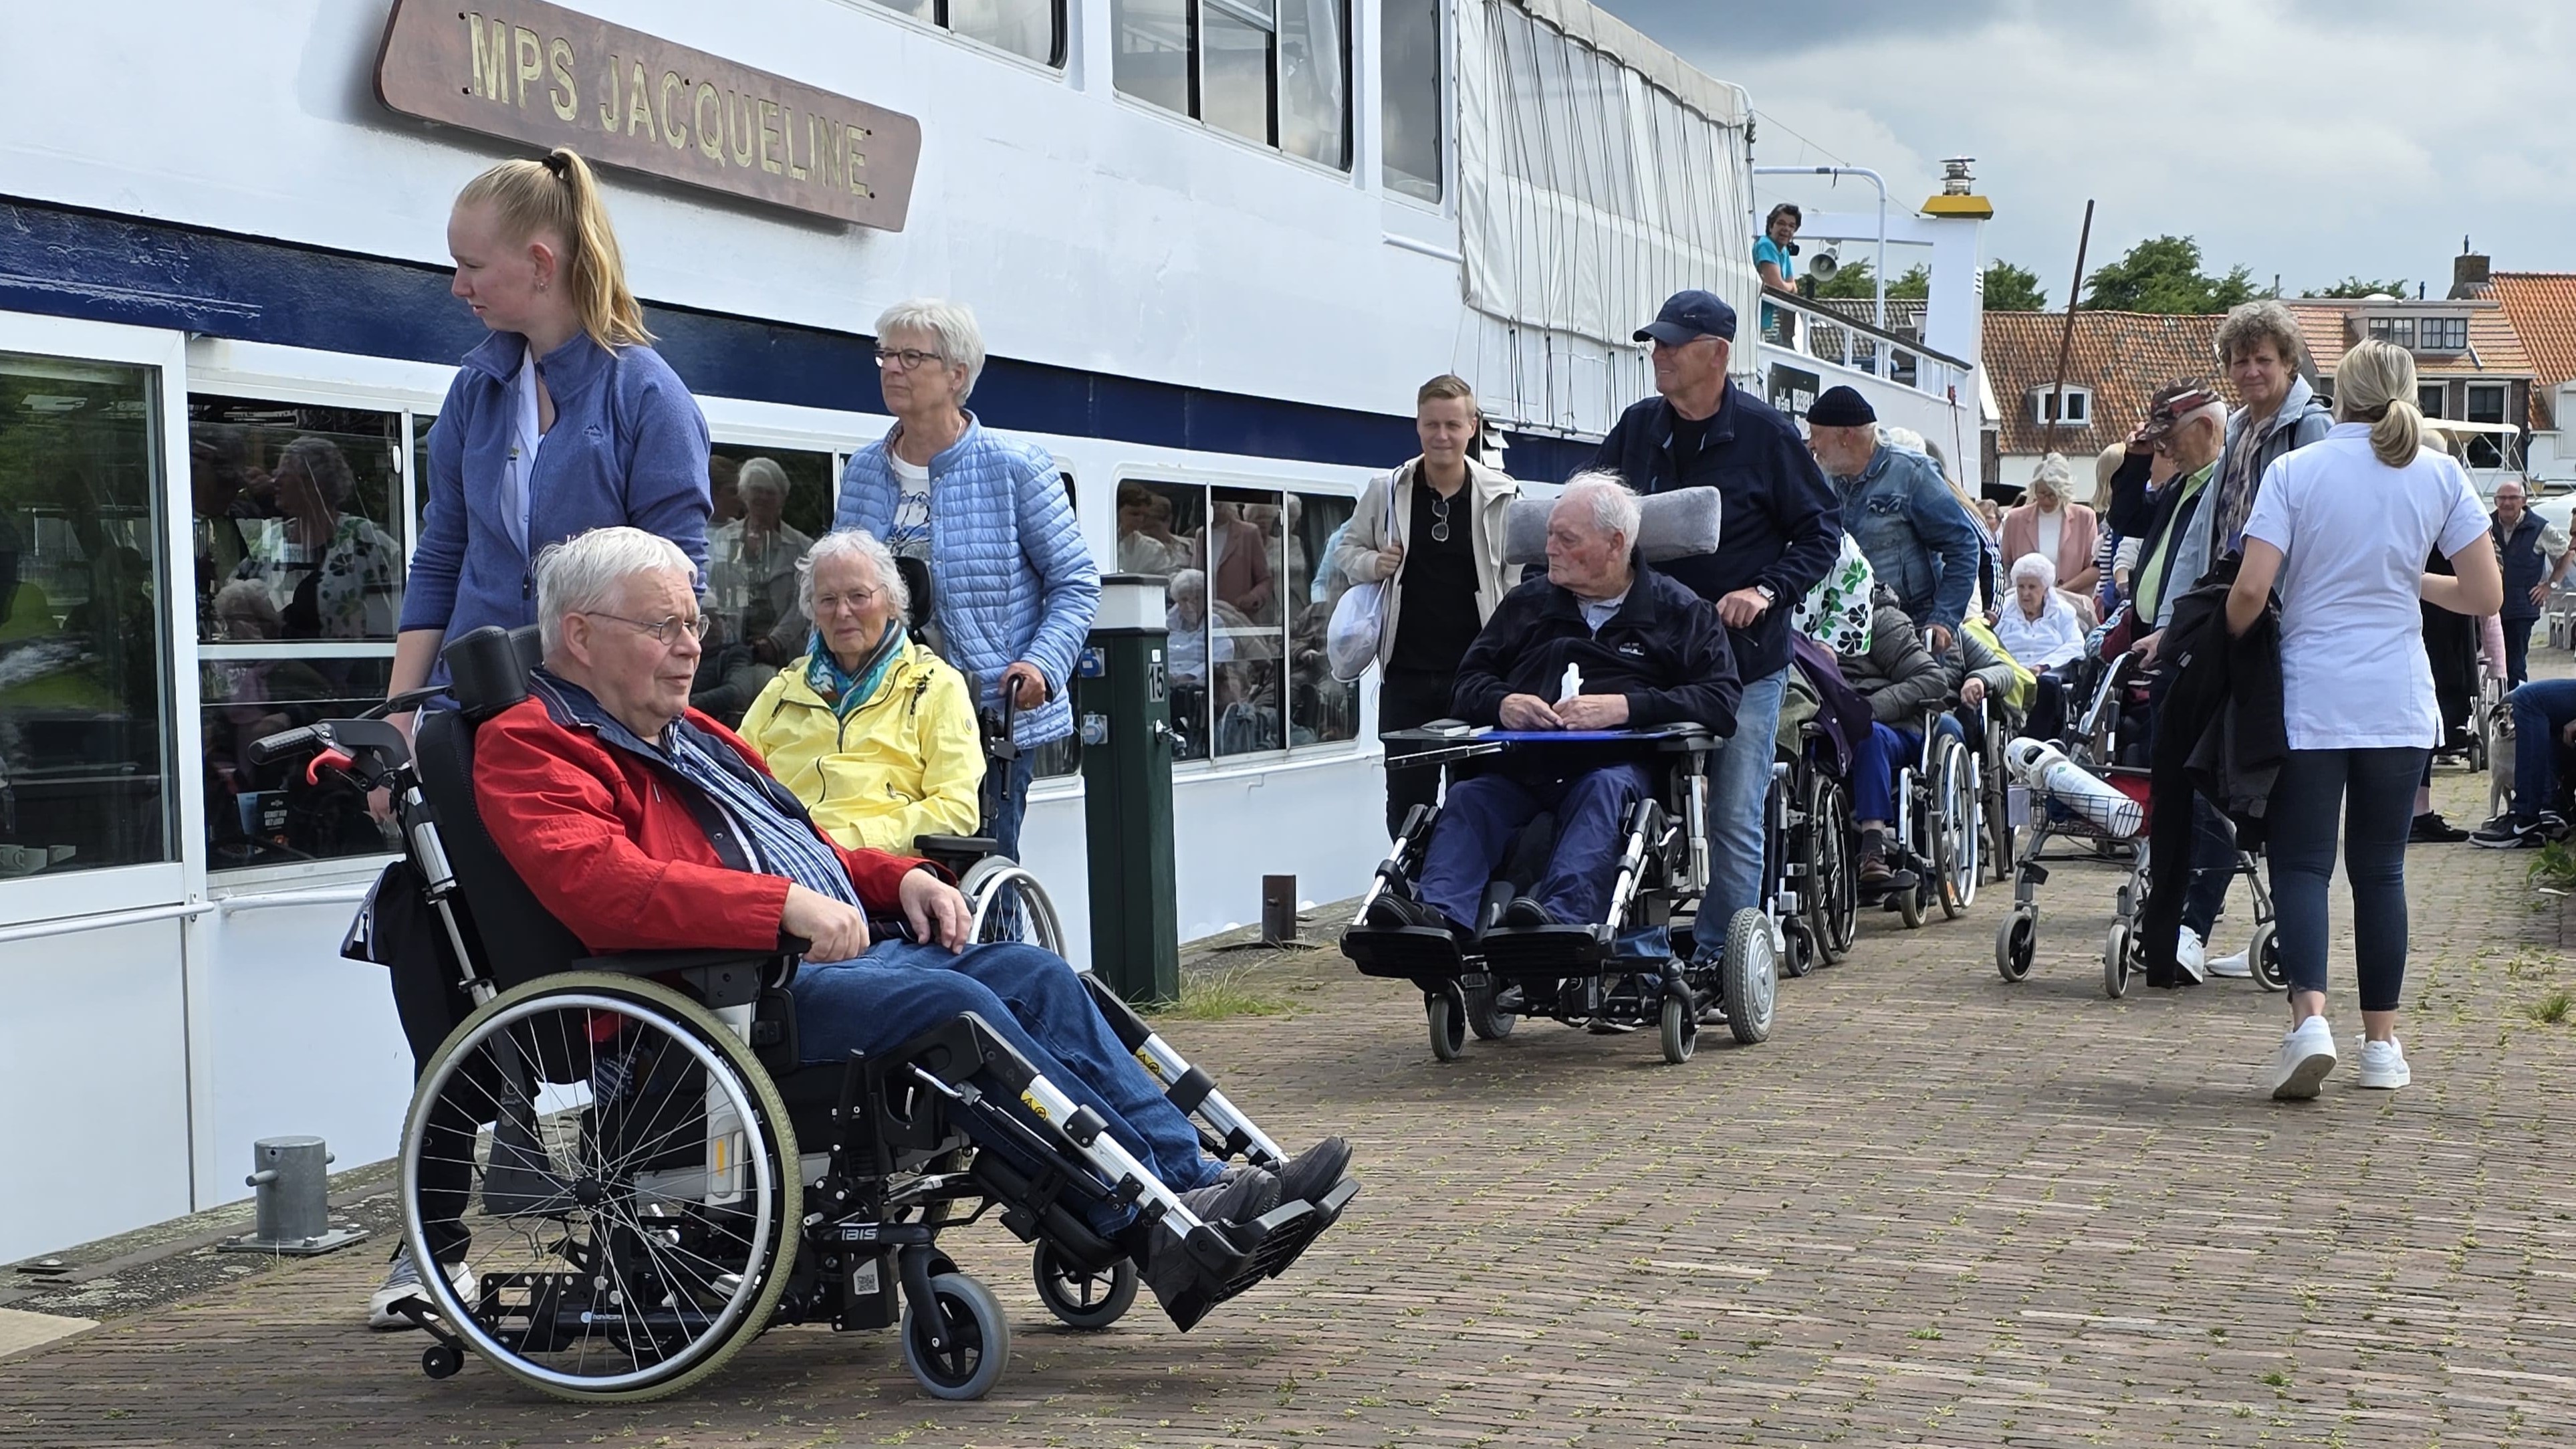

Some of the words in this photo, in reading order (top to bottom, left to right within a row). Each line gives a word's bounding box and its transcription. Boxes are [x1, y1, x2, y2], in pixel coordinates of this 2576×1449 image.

[469, 13, 578, 122] MPS
[600, 54, 868, 198] JACQUELINE
[1149, 666, 1164, 699] 15
